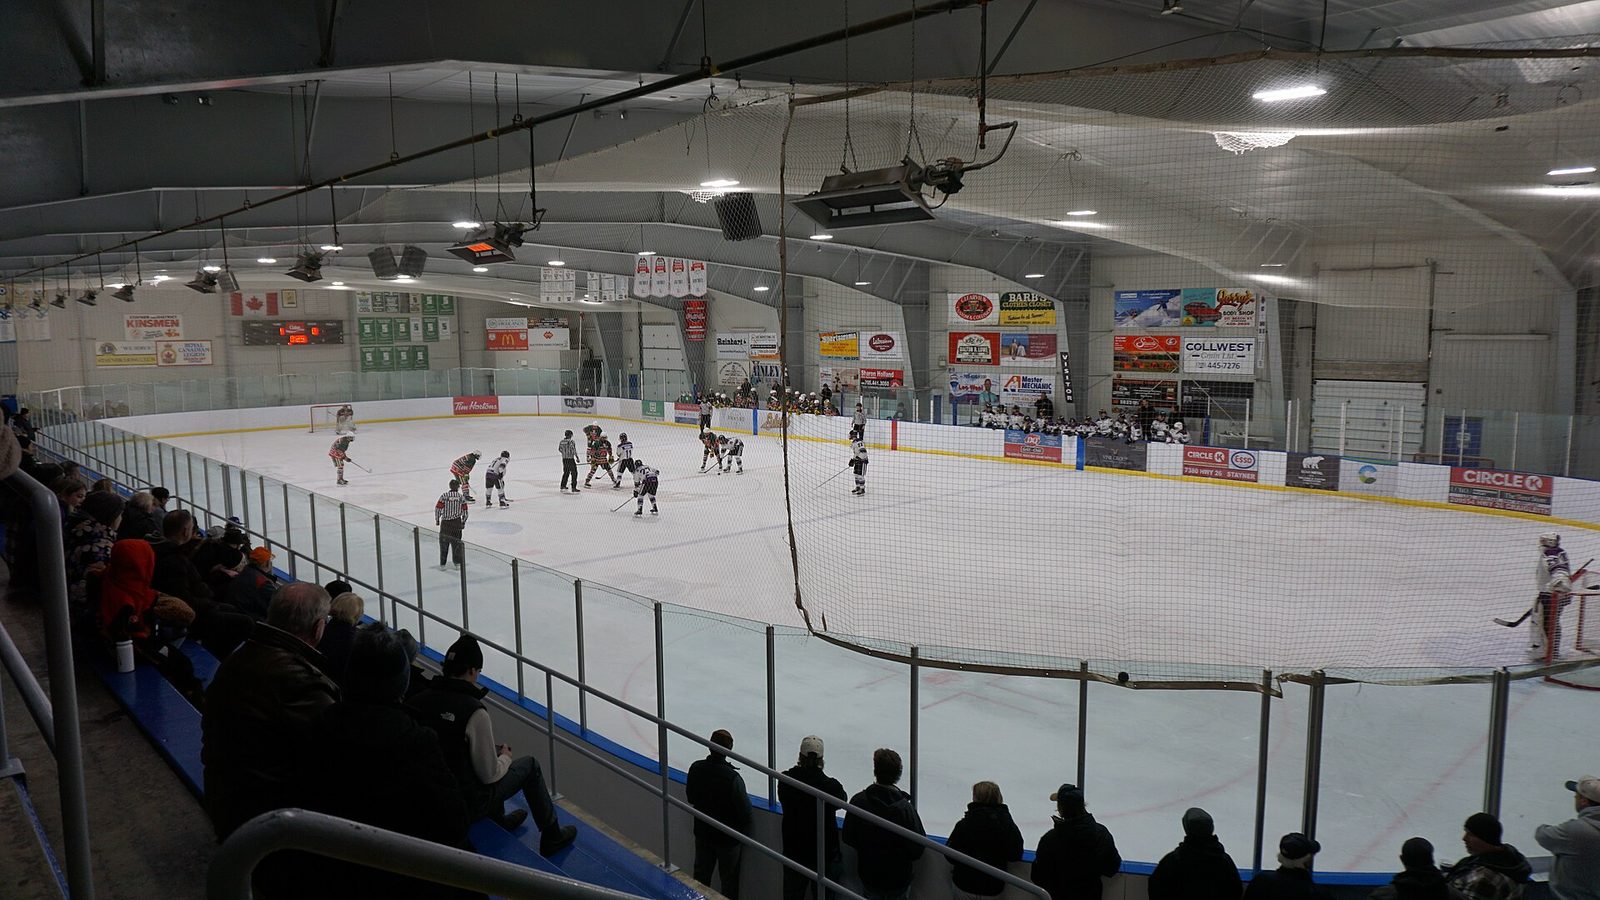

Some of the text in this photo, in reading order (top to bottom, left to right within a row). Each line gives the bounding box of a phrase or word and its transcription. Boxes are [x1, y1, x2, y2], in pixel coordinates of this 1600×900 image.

[126, 319, 179, 328] KINSMEN
[1186, 343, 1253, 352] COLLWEST
[1207, 362, 1241, 370] 445-7276
[1062, 354, 1073, 401] VISITOR
[455, 400, 497, 411] Tim Hortons
[1027, 436, 1040, 445] DQ
[1187, 451, 1225, 462] CIRCLE K
[1226, 471, 1256, 480] STAYNER
[1463, 470, 1543, 490] CIRCLE K
